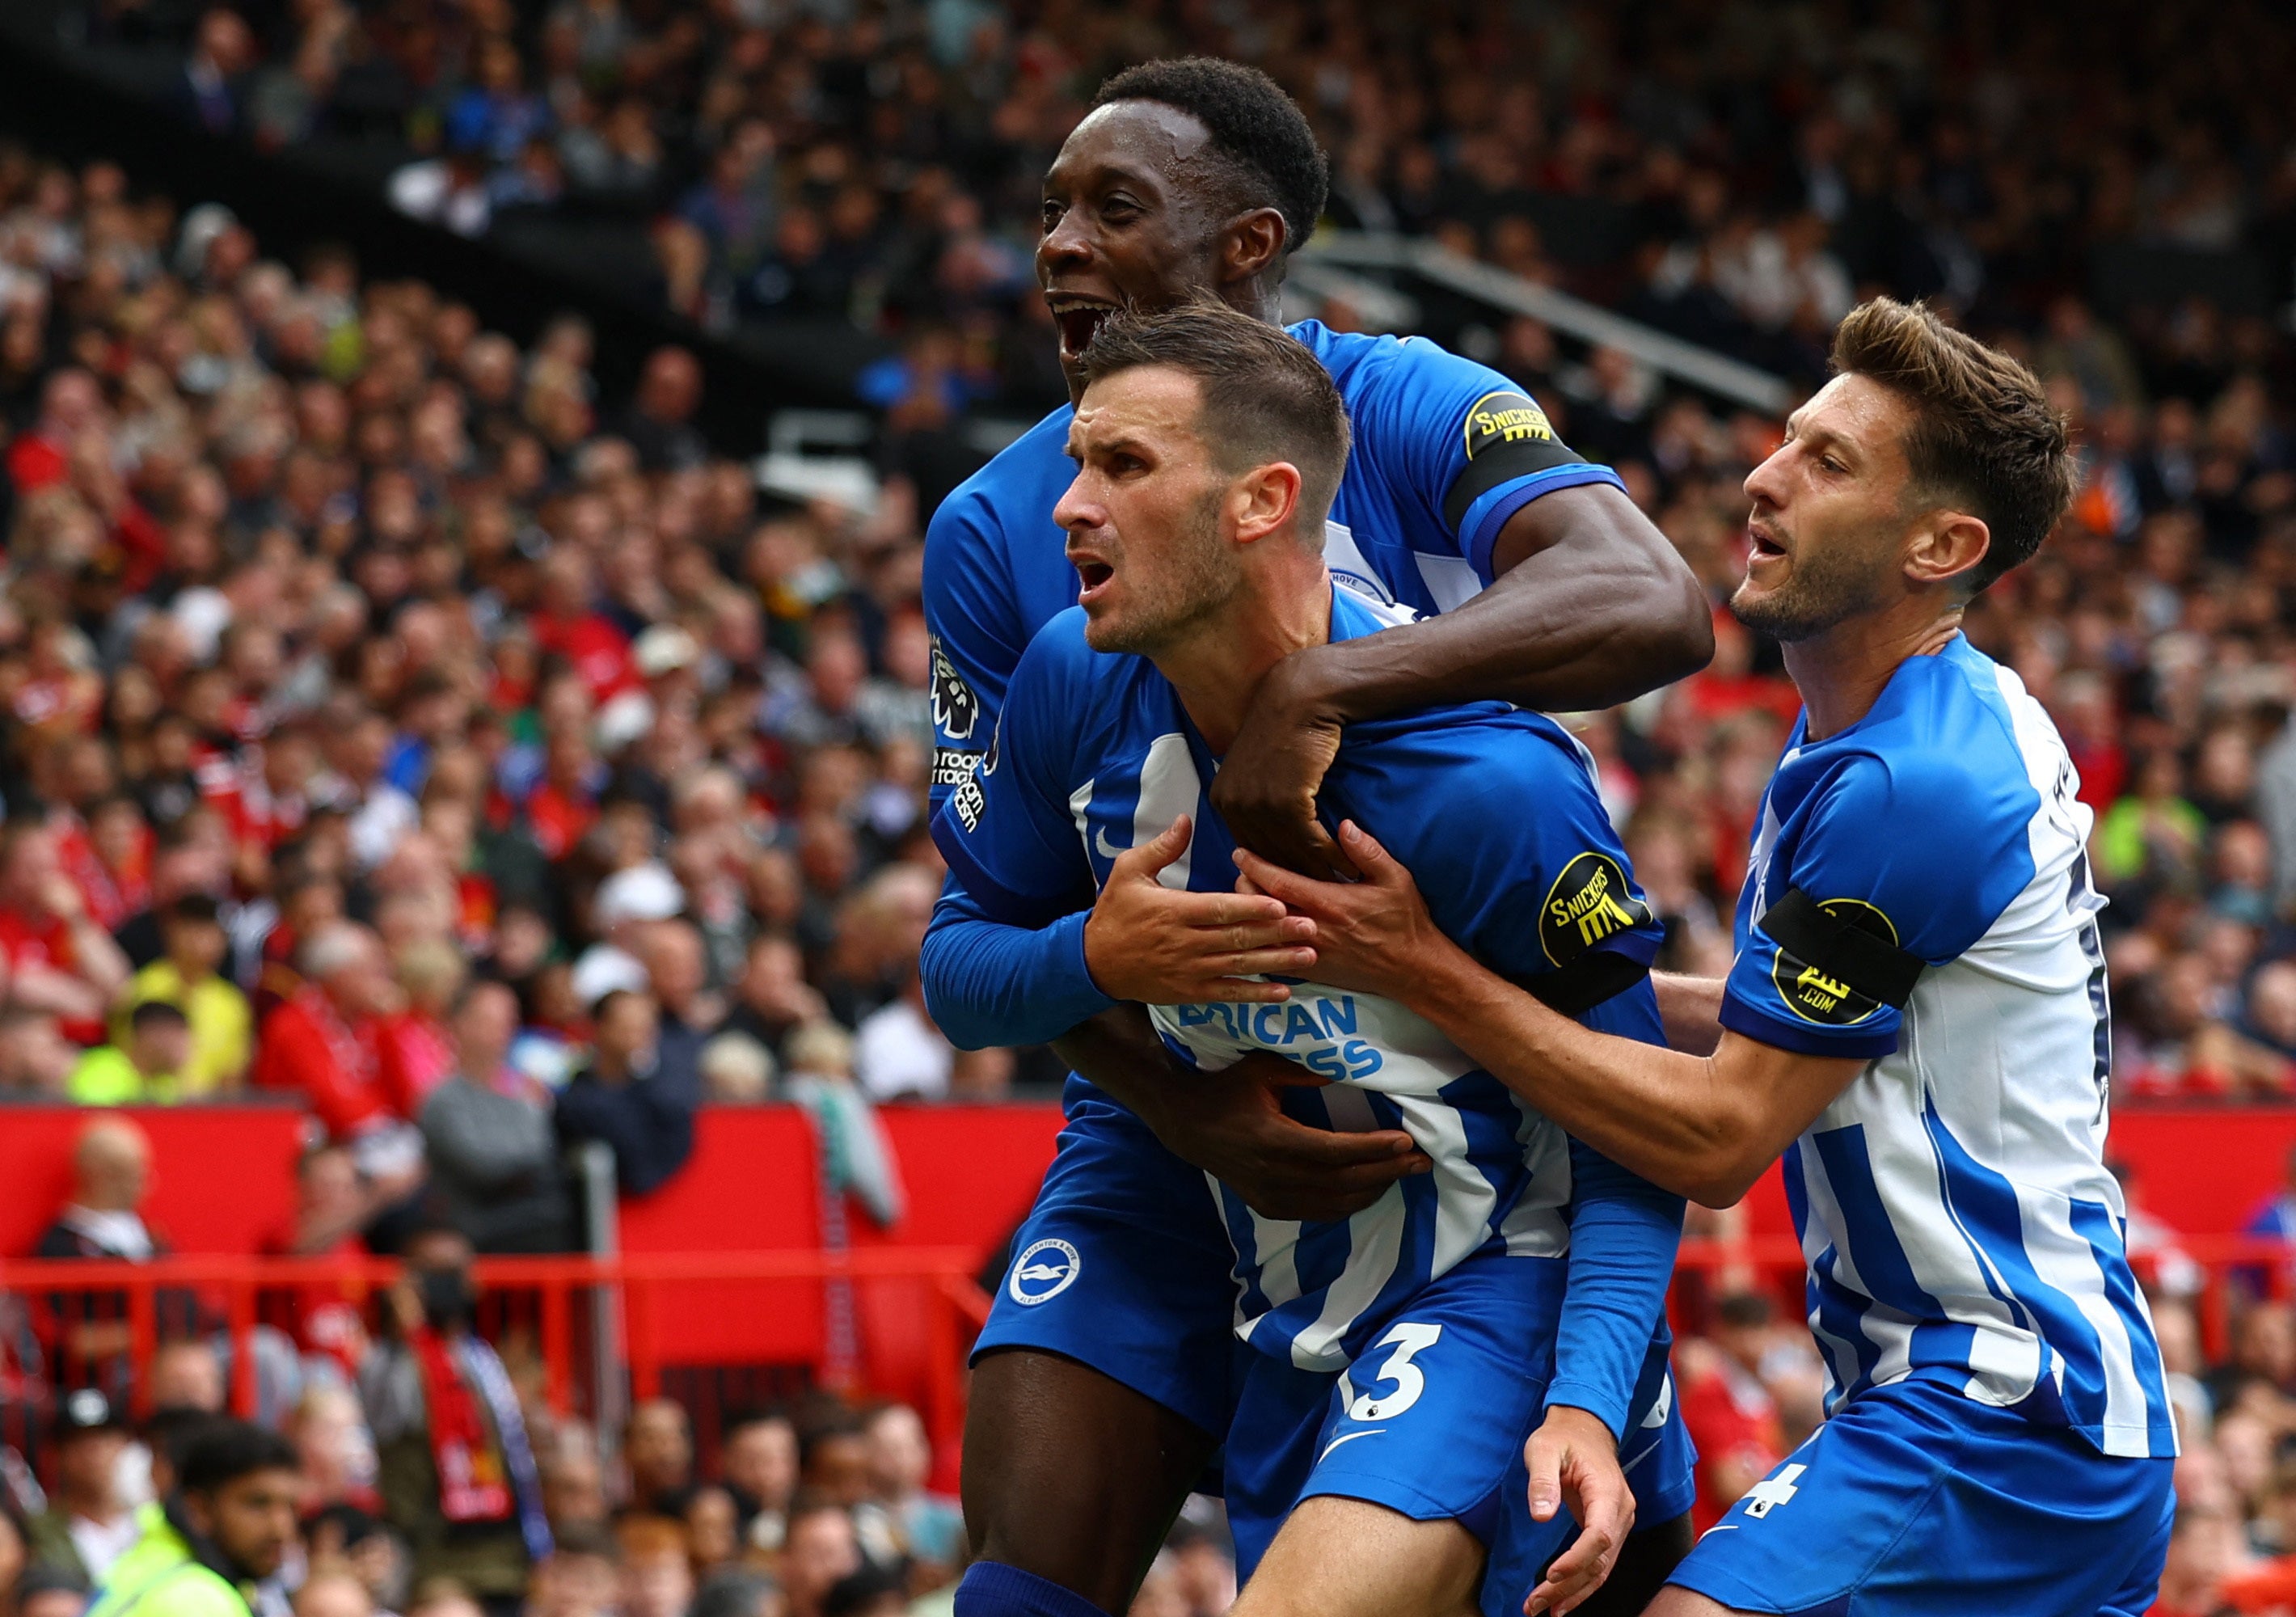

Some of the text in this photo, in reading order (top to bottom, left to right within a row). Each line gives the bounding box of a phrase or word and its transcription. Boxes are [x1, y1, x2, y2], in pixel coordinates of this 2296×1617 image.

[1332, 574, 1358, 587] HOVE
[1551, 865, 1608, 927] SNICKERS
[1798, 987, 1837, 1014] .COM
[1019, 1295, 1045, 1303] ALBION
